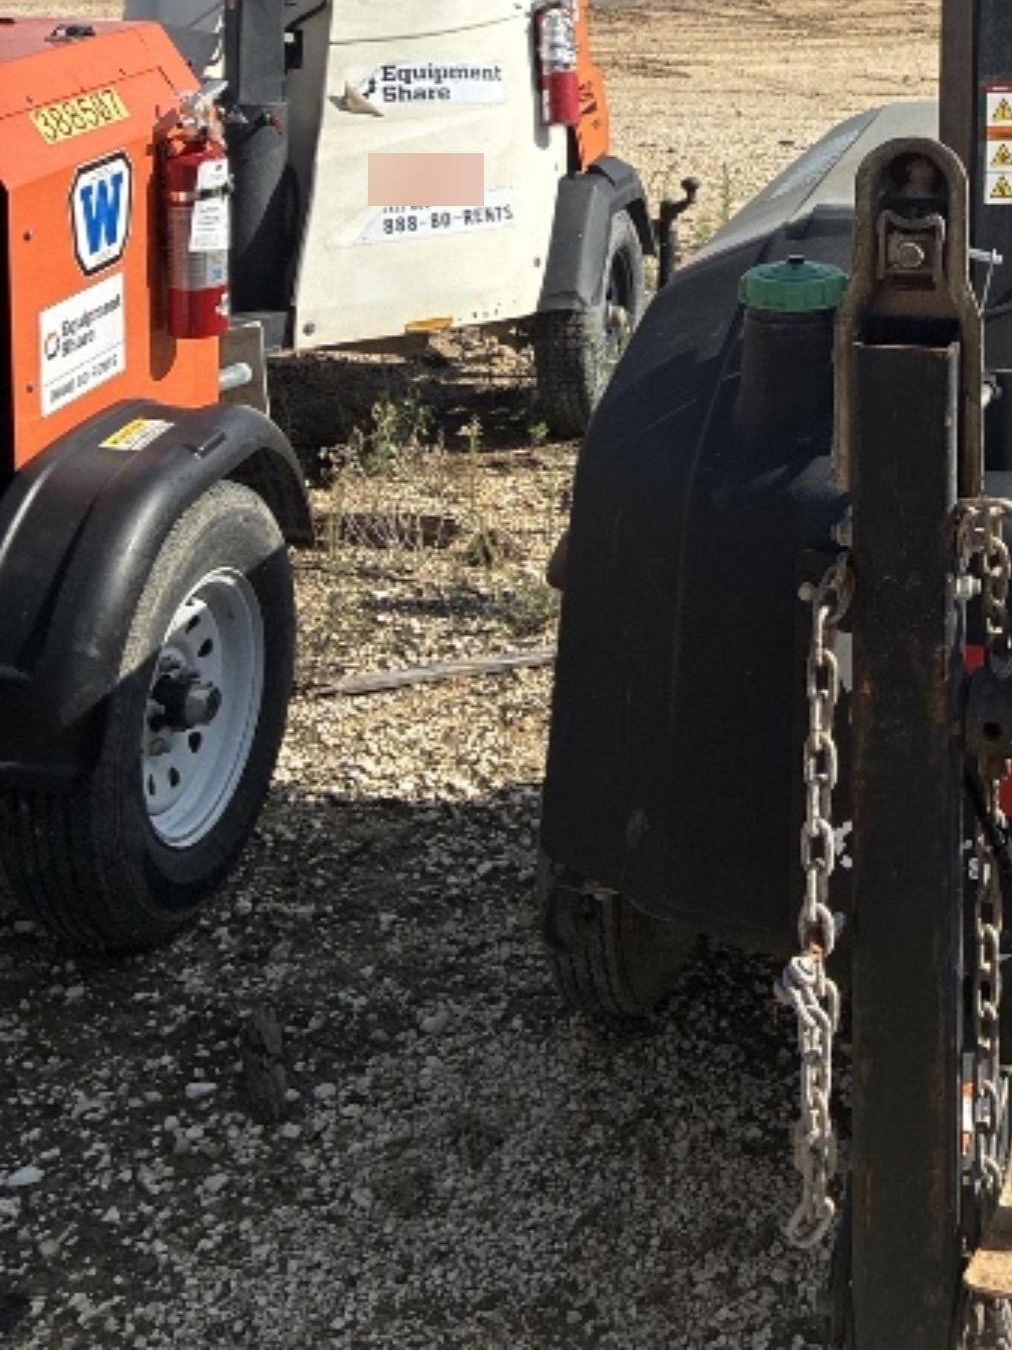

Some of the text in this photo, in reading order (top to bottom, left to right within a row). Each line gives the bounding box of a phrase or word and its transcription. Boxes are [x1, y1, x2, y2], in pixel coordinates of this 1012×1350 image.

[381, 62, 502, 84] Equipment
[382, 84, 451, 103] Share
[79, 171, 123, 256] W
